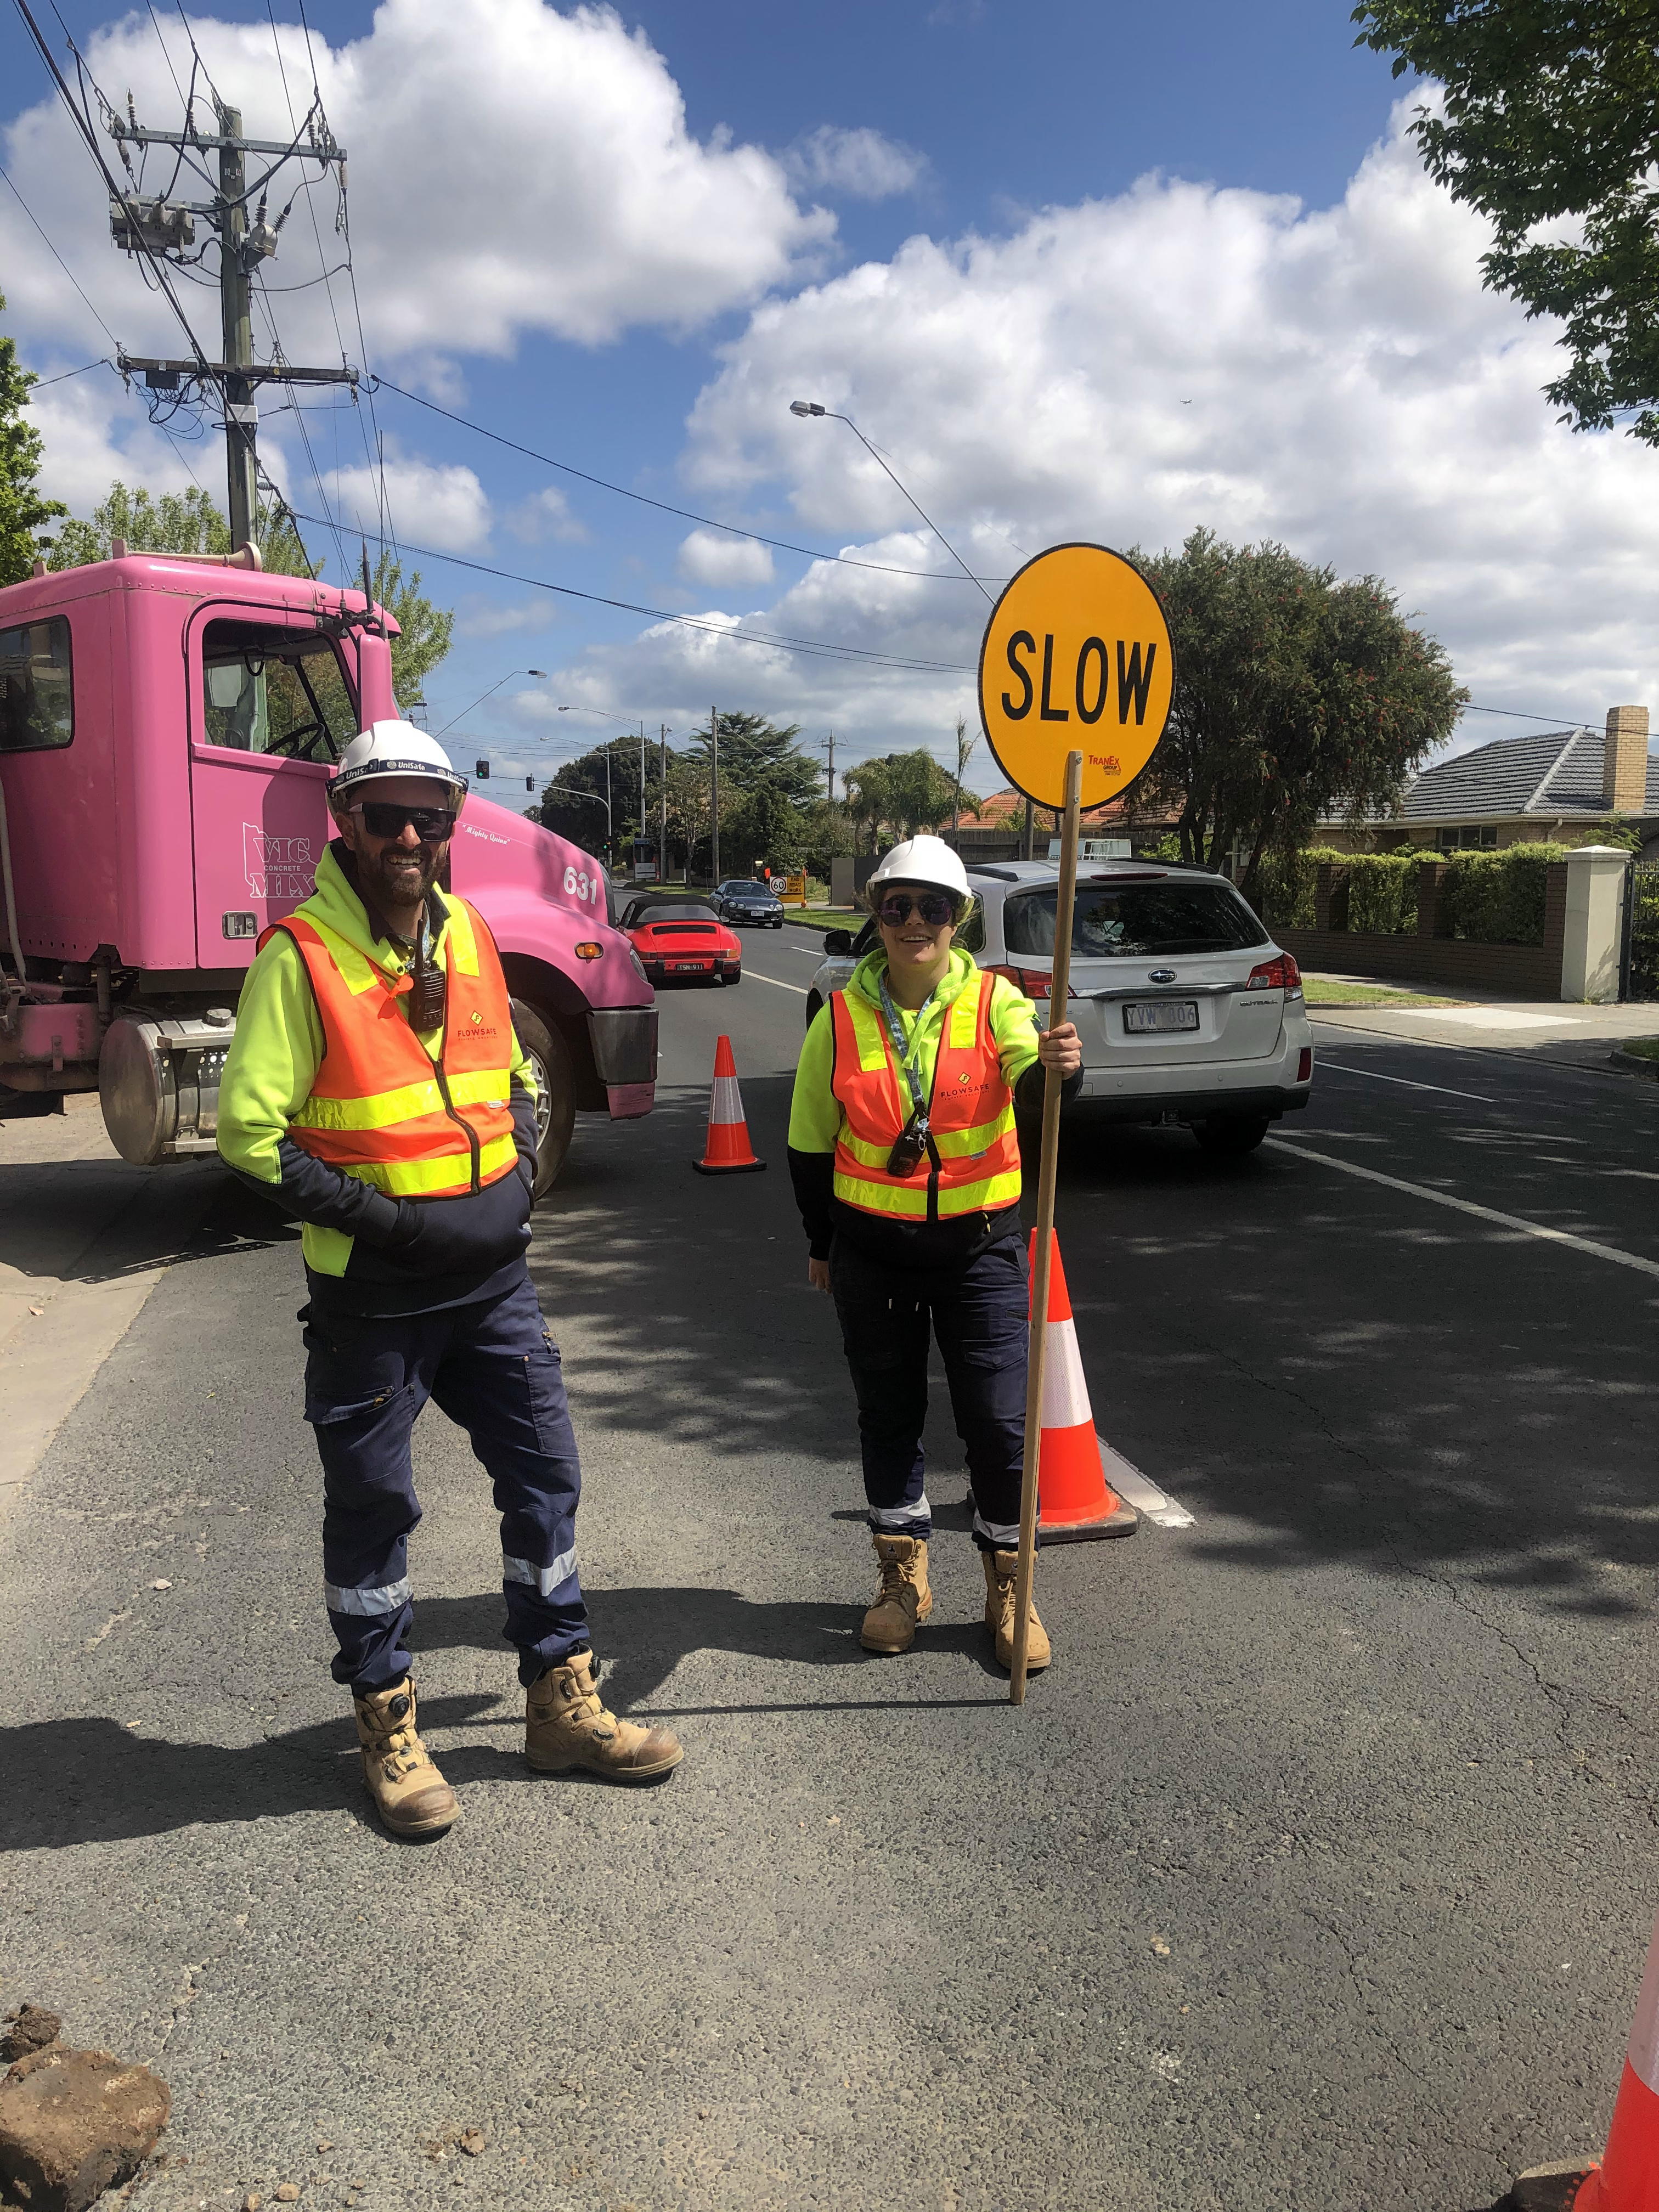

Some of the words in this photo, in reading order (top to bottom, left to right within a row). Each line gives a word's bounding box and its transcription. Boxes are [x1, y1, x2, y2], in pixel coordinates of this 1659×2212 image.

[1001, 629, 1157, 726] SLOW
[398, 761, 426, 771] UniSafe
[252, 837, 311, 864] VIC
[250, 873, 314, 898] MIX
[563, 866, 597, 905] 631
[773, 881, 784, 889] 60
[458, 1028, 497, 1037] FLOWSAFE
[940, 1084, 989, 1098] FLOWSAFE
